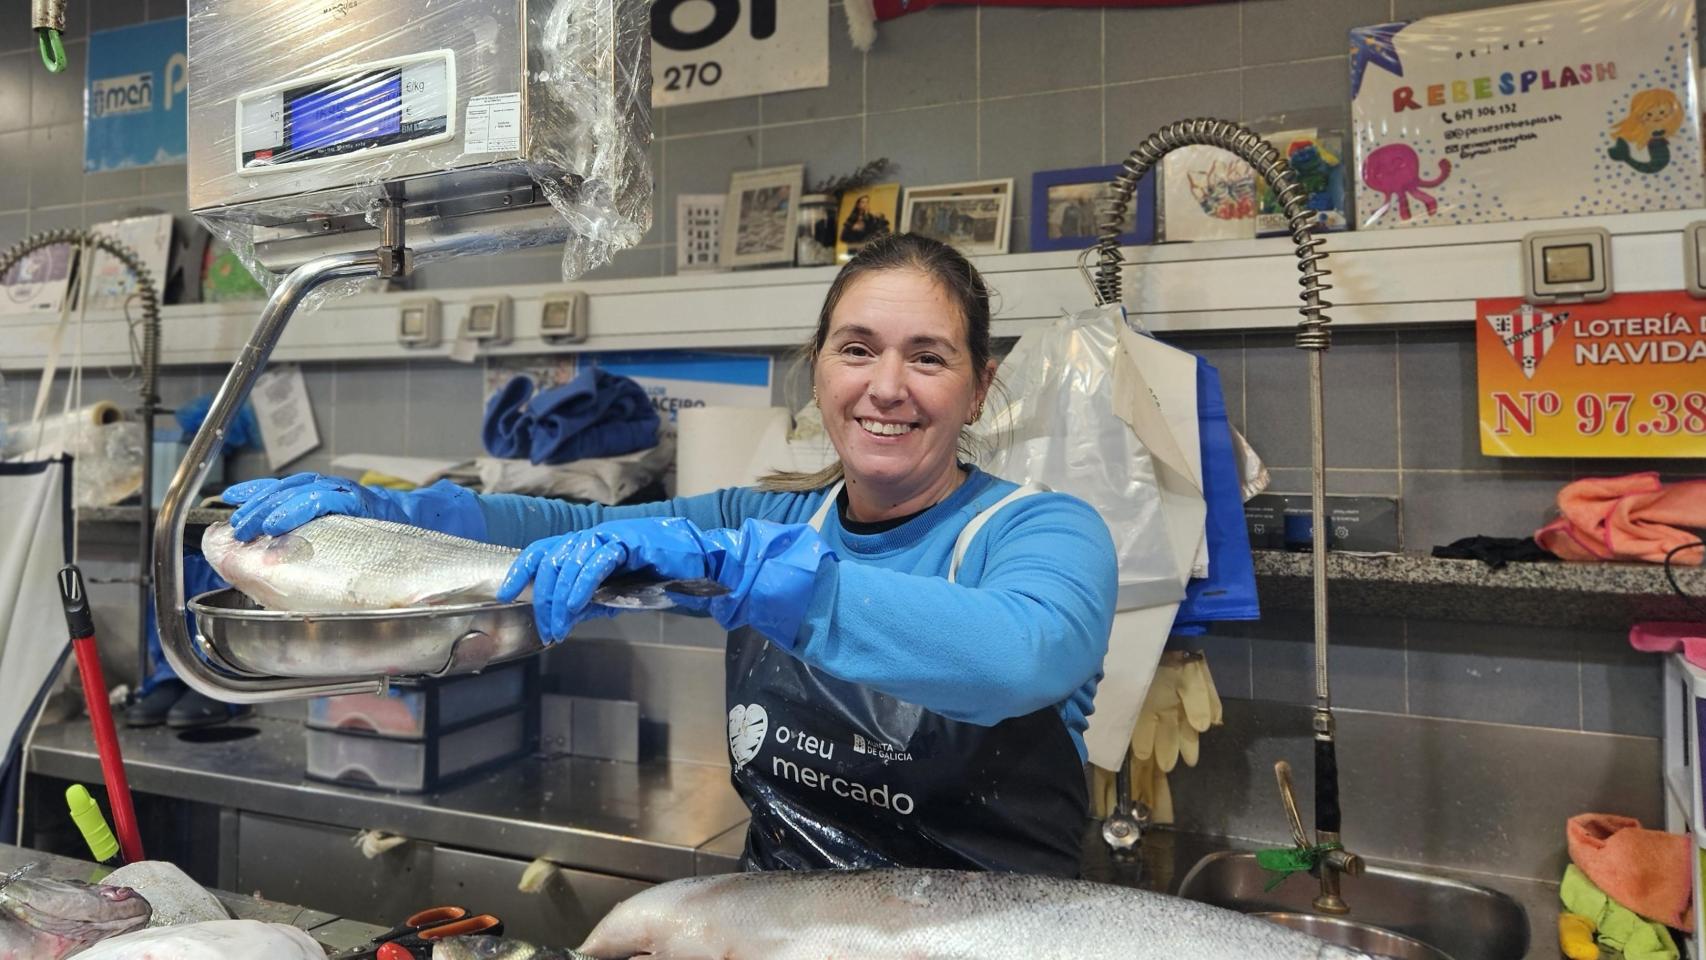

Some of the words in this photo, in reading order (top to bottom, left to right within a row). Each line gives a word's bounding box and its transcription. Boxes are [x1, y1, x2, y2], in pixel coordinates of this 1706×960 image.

[664, 61, 722, 91] 270
[1393, 61, 1617, 113] REBESPLASH
[1574, 313, 1692, 337] LOTERÍA
[1492, 390, 1561, 435] Nº
[1575, 391, 1706, 435] 97.38
[796, 731, 834, 760] teu
[878, 750, 913, 762] GALICIA
[772, 756, 914, 815] mercado
